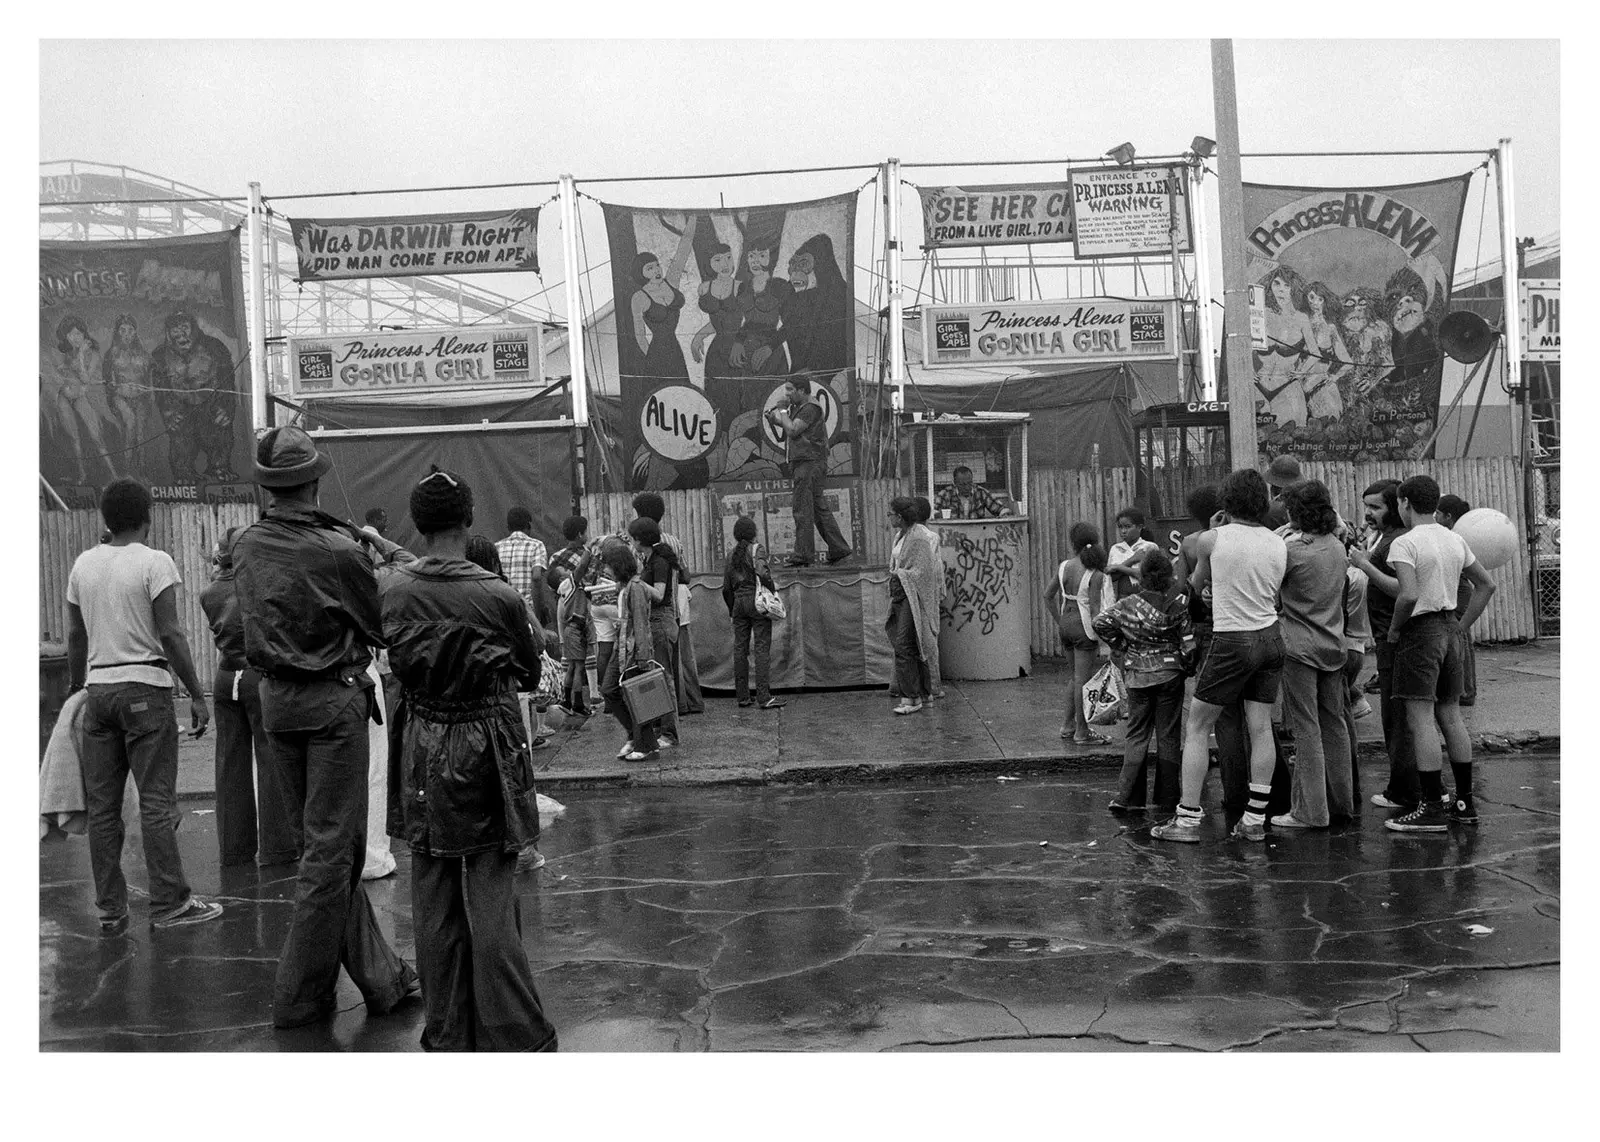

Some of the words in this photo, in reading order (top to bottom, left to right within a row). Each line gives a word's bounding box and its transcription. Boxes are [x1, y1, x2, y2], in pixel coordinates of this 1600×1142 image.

[1089, 172, 1138, 182] ENTRANCE
[1074, 182, 1133, 202] PRINCESS
[934, 196, 978, 223] SEE
[990, 194, 1037, 220] HER
[1088, 195, 1163, 213] WARNING
[934, 225, 965, 240] FROM
[967, 226, 976, 237] A
[978, 223, 1002, 238] LIVE
[1037, 221, 1052, 235] TO
[1055, 221, 1064, 234] A
[1250, 199, 1343, 257] Princess
[1340, 193, 1439, 258] ALENA
[357, 224, 453, 252] DARWIN
[314, 257, 341, 272] DID
[347, 255, 382, 270] MAN
[389, 252, 437, 268] COME
[443, 250, 490, 265] FROM
[495, 246, 525, 262] APE
[39, 270, 132, 299] INCESS
[973, 310, 1060, 333] Princess
[1063, 307, 1126, 328] Alena
[1132, 315, 1164, 325] ALIVE!
[937, 324, 959, 333] GIRL
[1132, 330, 1164, 340] STAGE
[941, 332, 963, 341] GOES
[946, 335, 969, 348] APE!
[1073, 328, 1127, 353] GIRL
[335, 340, 424, 364] Princess
[426, 336, 488, 358] Alena
[495, 343, 527, 353] ALIVE!
[300, 356, 321, 365] GIRL
[495, 358, 527, 368] STAGE
[304, 363, 325, 373] GOES
[309, 365, 331, 378] APE!
[435, 358, 490, 381] GIRL
[646, 396, 712, 446] ALIVE
[1256, 415, 1274, 424] son
[1373, 411, 1386, 422] En
[1390, 409, 1427, 421] Persona
[1266, 442, 1282, 451] her
[1287, 440, 1324, 453] change
[1329, 440, 1347, 450] from
[1349, 438, 1363, 452] girl
[1365, 439, 1373, 449] to
[1375, 438, 1400, 453] gorilla
[151, 486, 197, 499] CHANGE
[222, 486, 235, 495] EN
